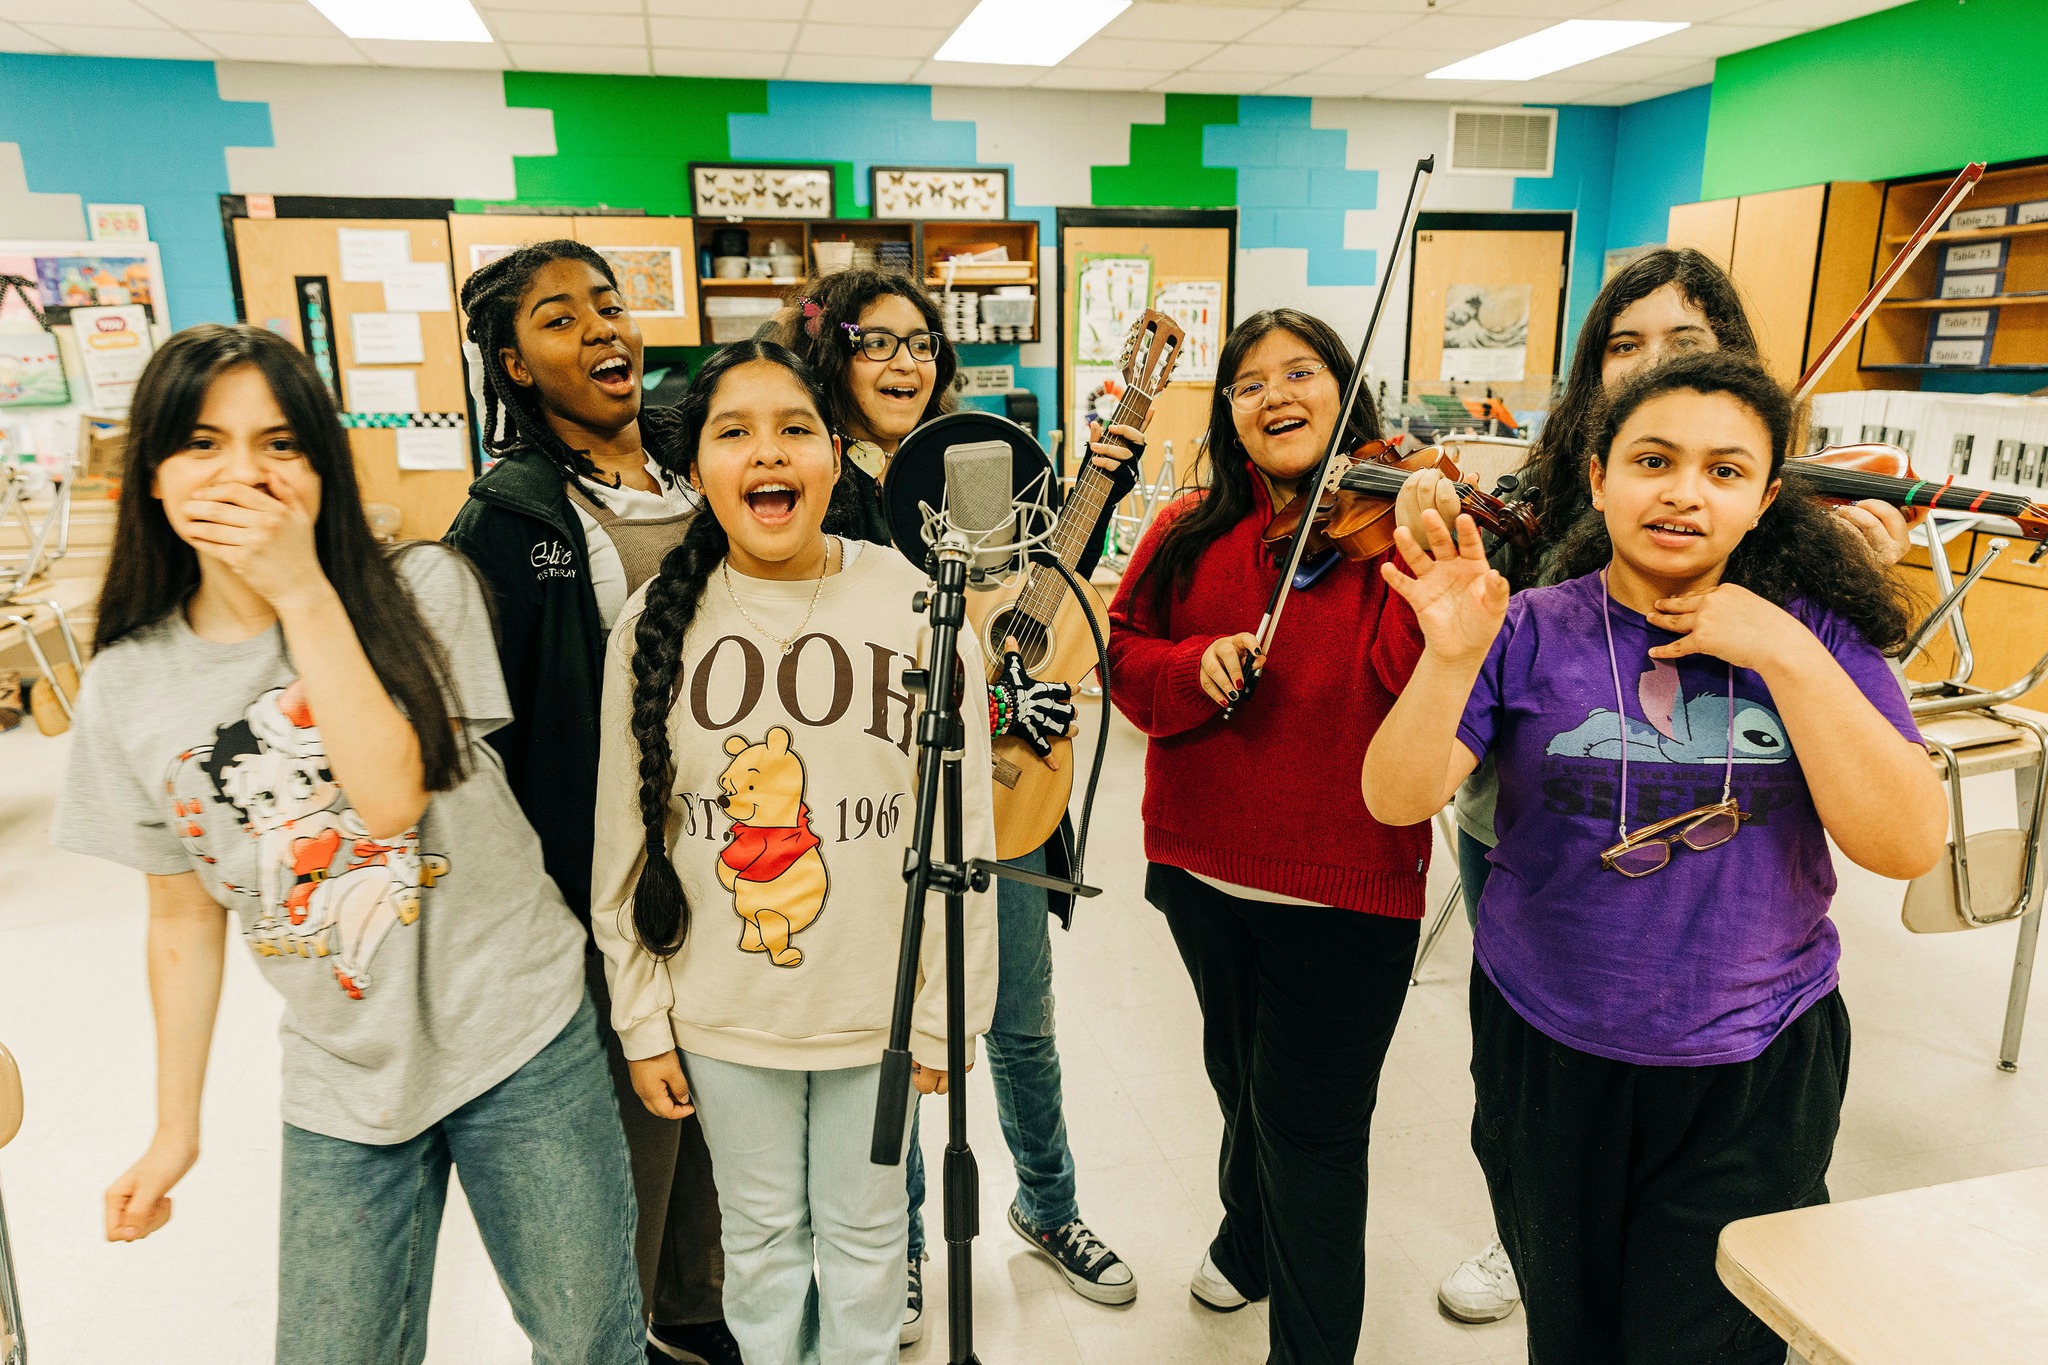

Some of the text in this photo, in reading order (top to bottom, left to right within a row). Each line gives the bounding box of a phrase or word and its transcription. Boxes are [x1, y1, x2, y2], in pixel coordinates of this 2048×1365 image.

[1956, 214, 1998, 227] Table 75
[1953, 249, 1991, 261] Table 73
[1947, 286, 1970, 296] Table
[1945, 317, 1982, 327] Table 71
[1936, 351, 1973, 361] Table 72
[835, 792, 906, 843] 1966
